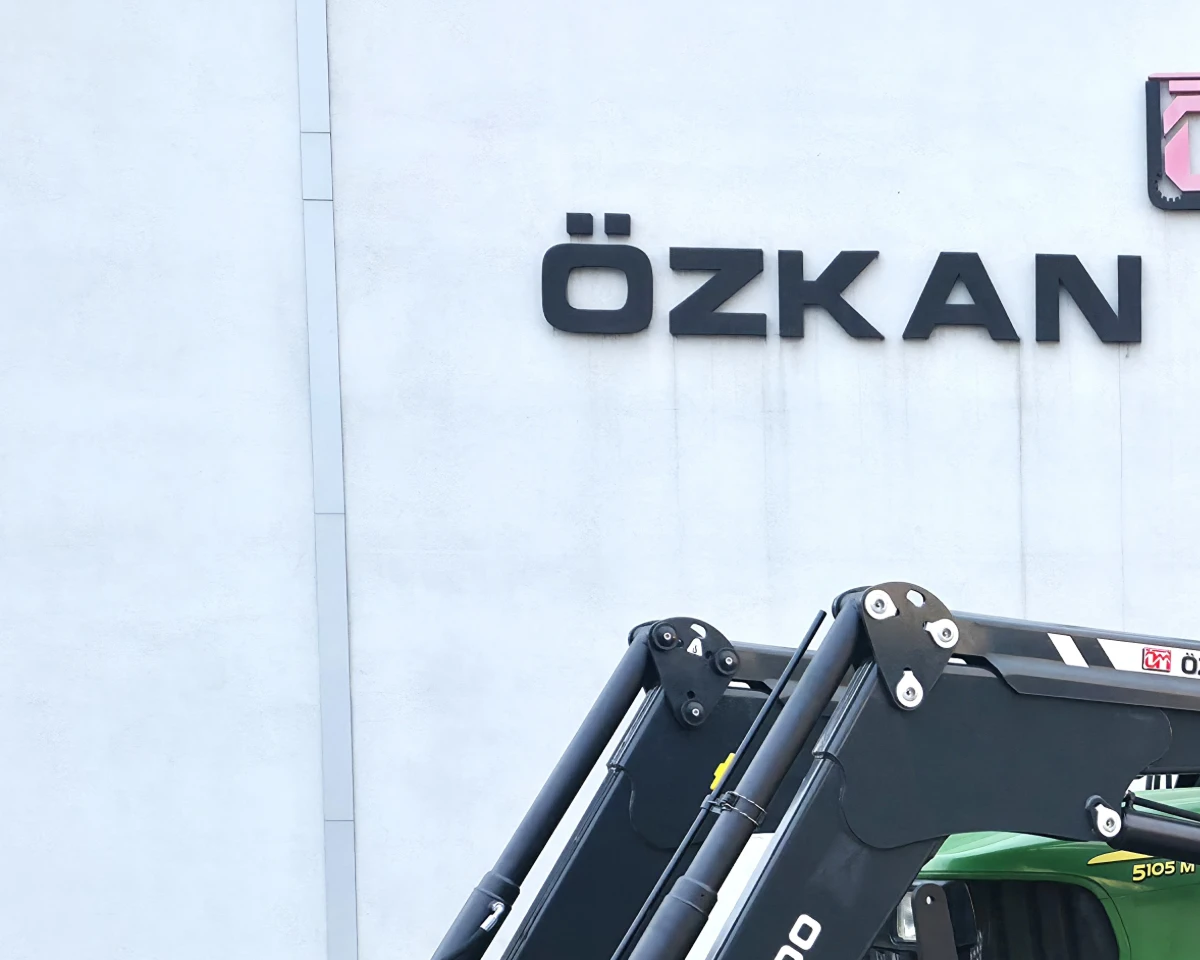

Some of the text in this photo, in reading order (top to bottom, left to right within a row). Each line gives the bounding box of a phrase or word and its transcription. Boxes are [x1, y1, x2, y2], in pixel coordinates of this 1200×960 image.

[541, 212, 1142, 343] ÖZKAN
[1132, 860, 1196, 883] 5105 M
